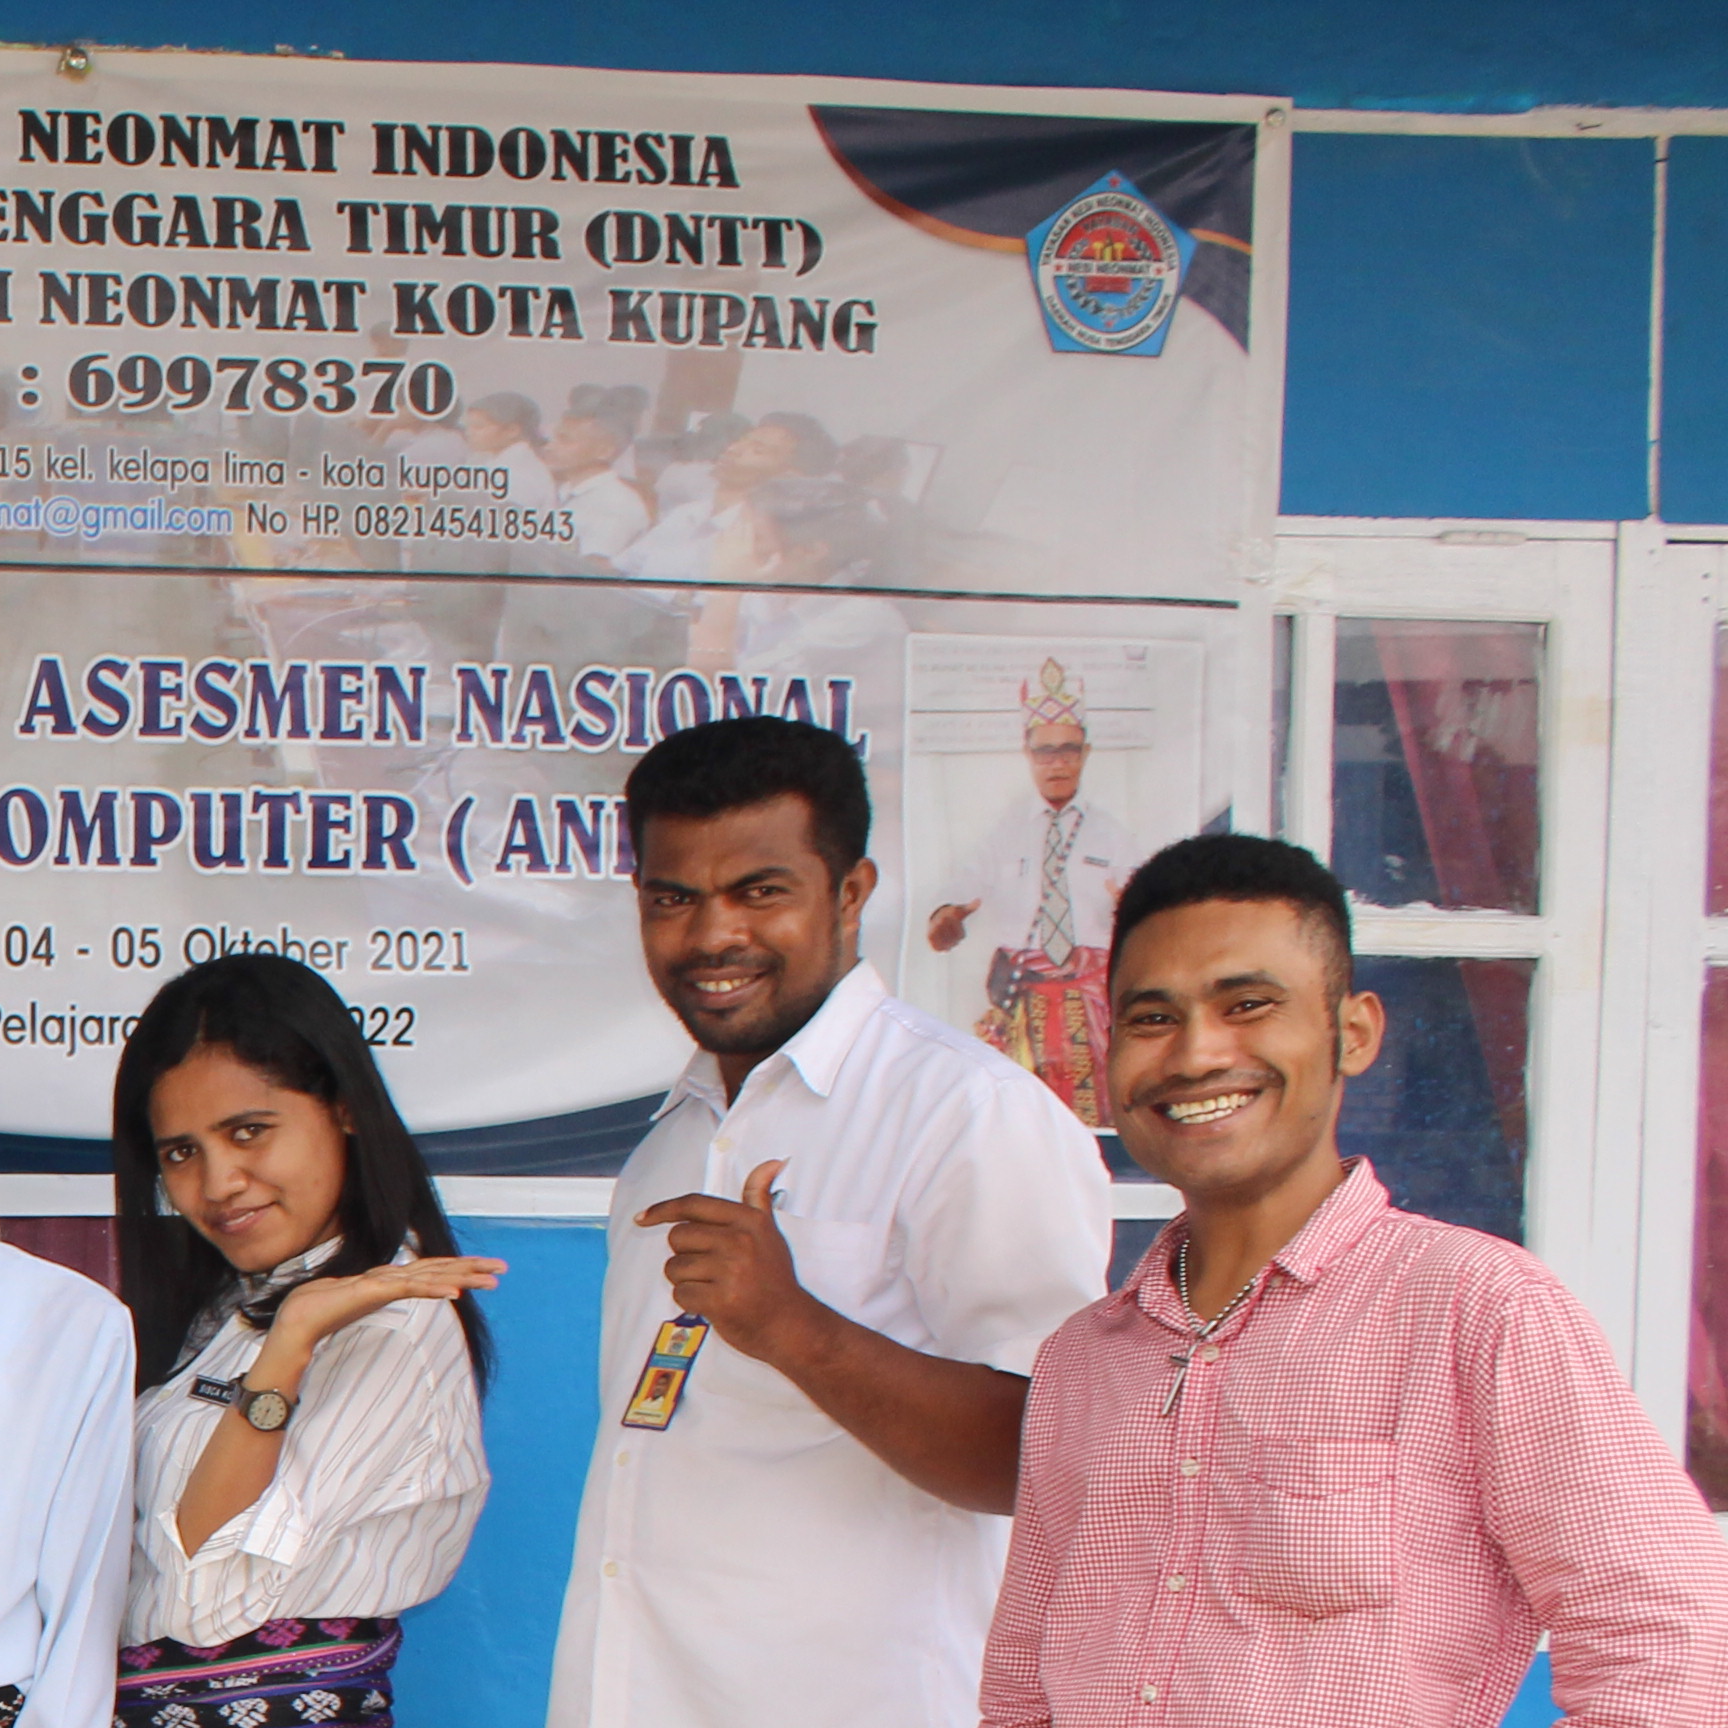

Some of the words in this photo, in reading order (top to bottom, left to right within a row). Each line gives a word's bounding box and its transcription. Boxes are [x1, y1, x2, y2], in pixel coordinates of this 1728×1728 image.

[19, 109, 344, 174] NEONMAT
[372, 121, 739, 188] INDONESIA
[337, 200, 560, 261] TIMUR
[585, 209, 824, 275] (DNTT)
[40, 271, 366, 334] NEONMAT
[394, 282, 581, 339] KOTA
[609, 289, 876, 353] KUPANG
[22, 367, 37, 405] :
[69, 353, 455, 417] 69978370
[45, 445, 93, 481] kel.
[108, 448, 209, 493] kelapa
[224, 450, 283, 486] lima
[323, 454, 384, 490] kota
[400, 455, 509, 500] kupang
[247, 500, 288, 535] No
[302, 501, 339, 536] HP.
[354, 503, 575, 542] 082145418543
[21, 658, 424, 741] ASESMEN
[5, 926, 54, 967] 04
[112, 928, 162, 969] 05
[370, 932, 470, 971] 2021
